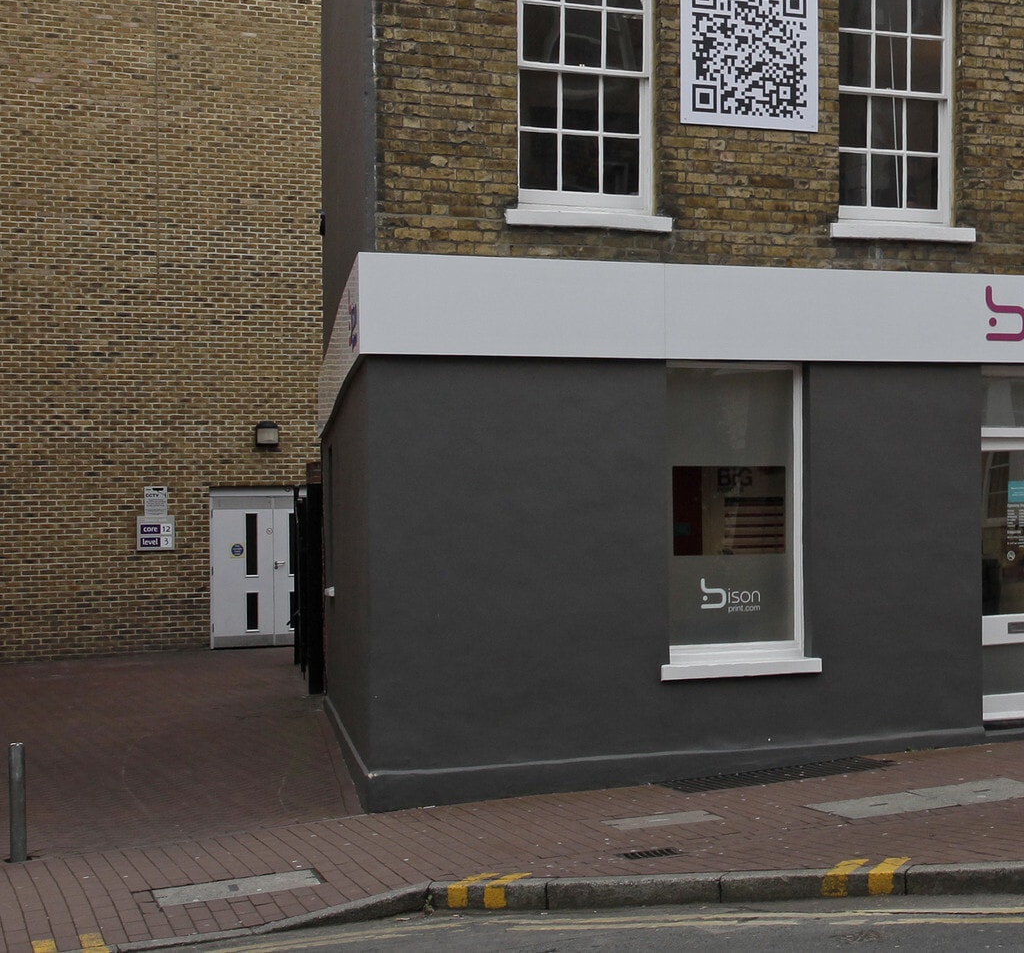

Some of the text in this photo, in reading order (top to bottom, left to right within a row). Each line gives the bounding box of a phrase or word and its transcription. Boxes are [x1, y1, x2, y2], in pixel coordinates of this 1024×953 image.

[142, 537, 169, 546] level 3
[700, 578, 761, 609] bison
[727, 604, 761, 614] print.com
